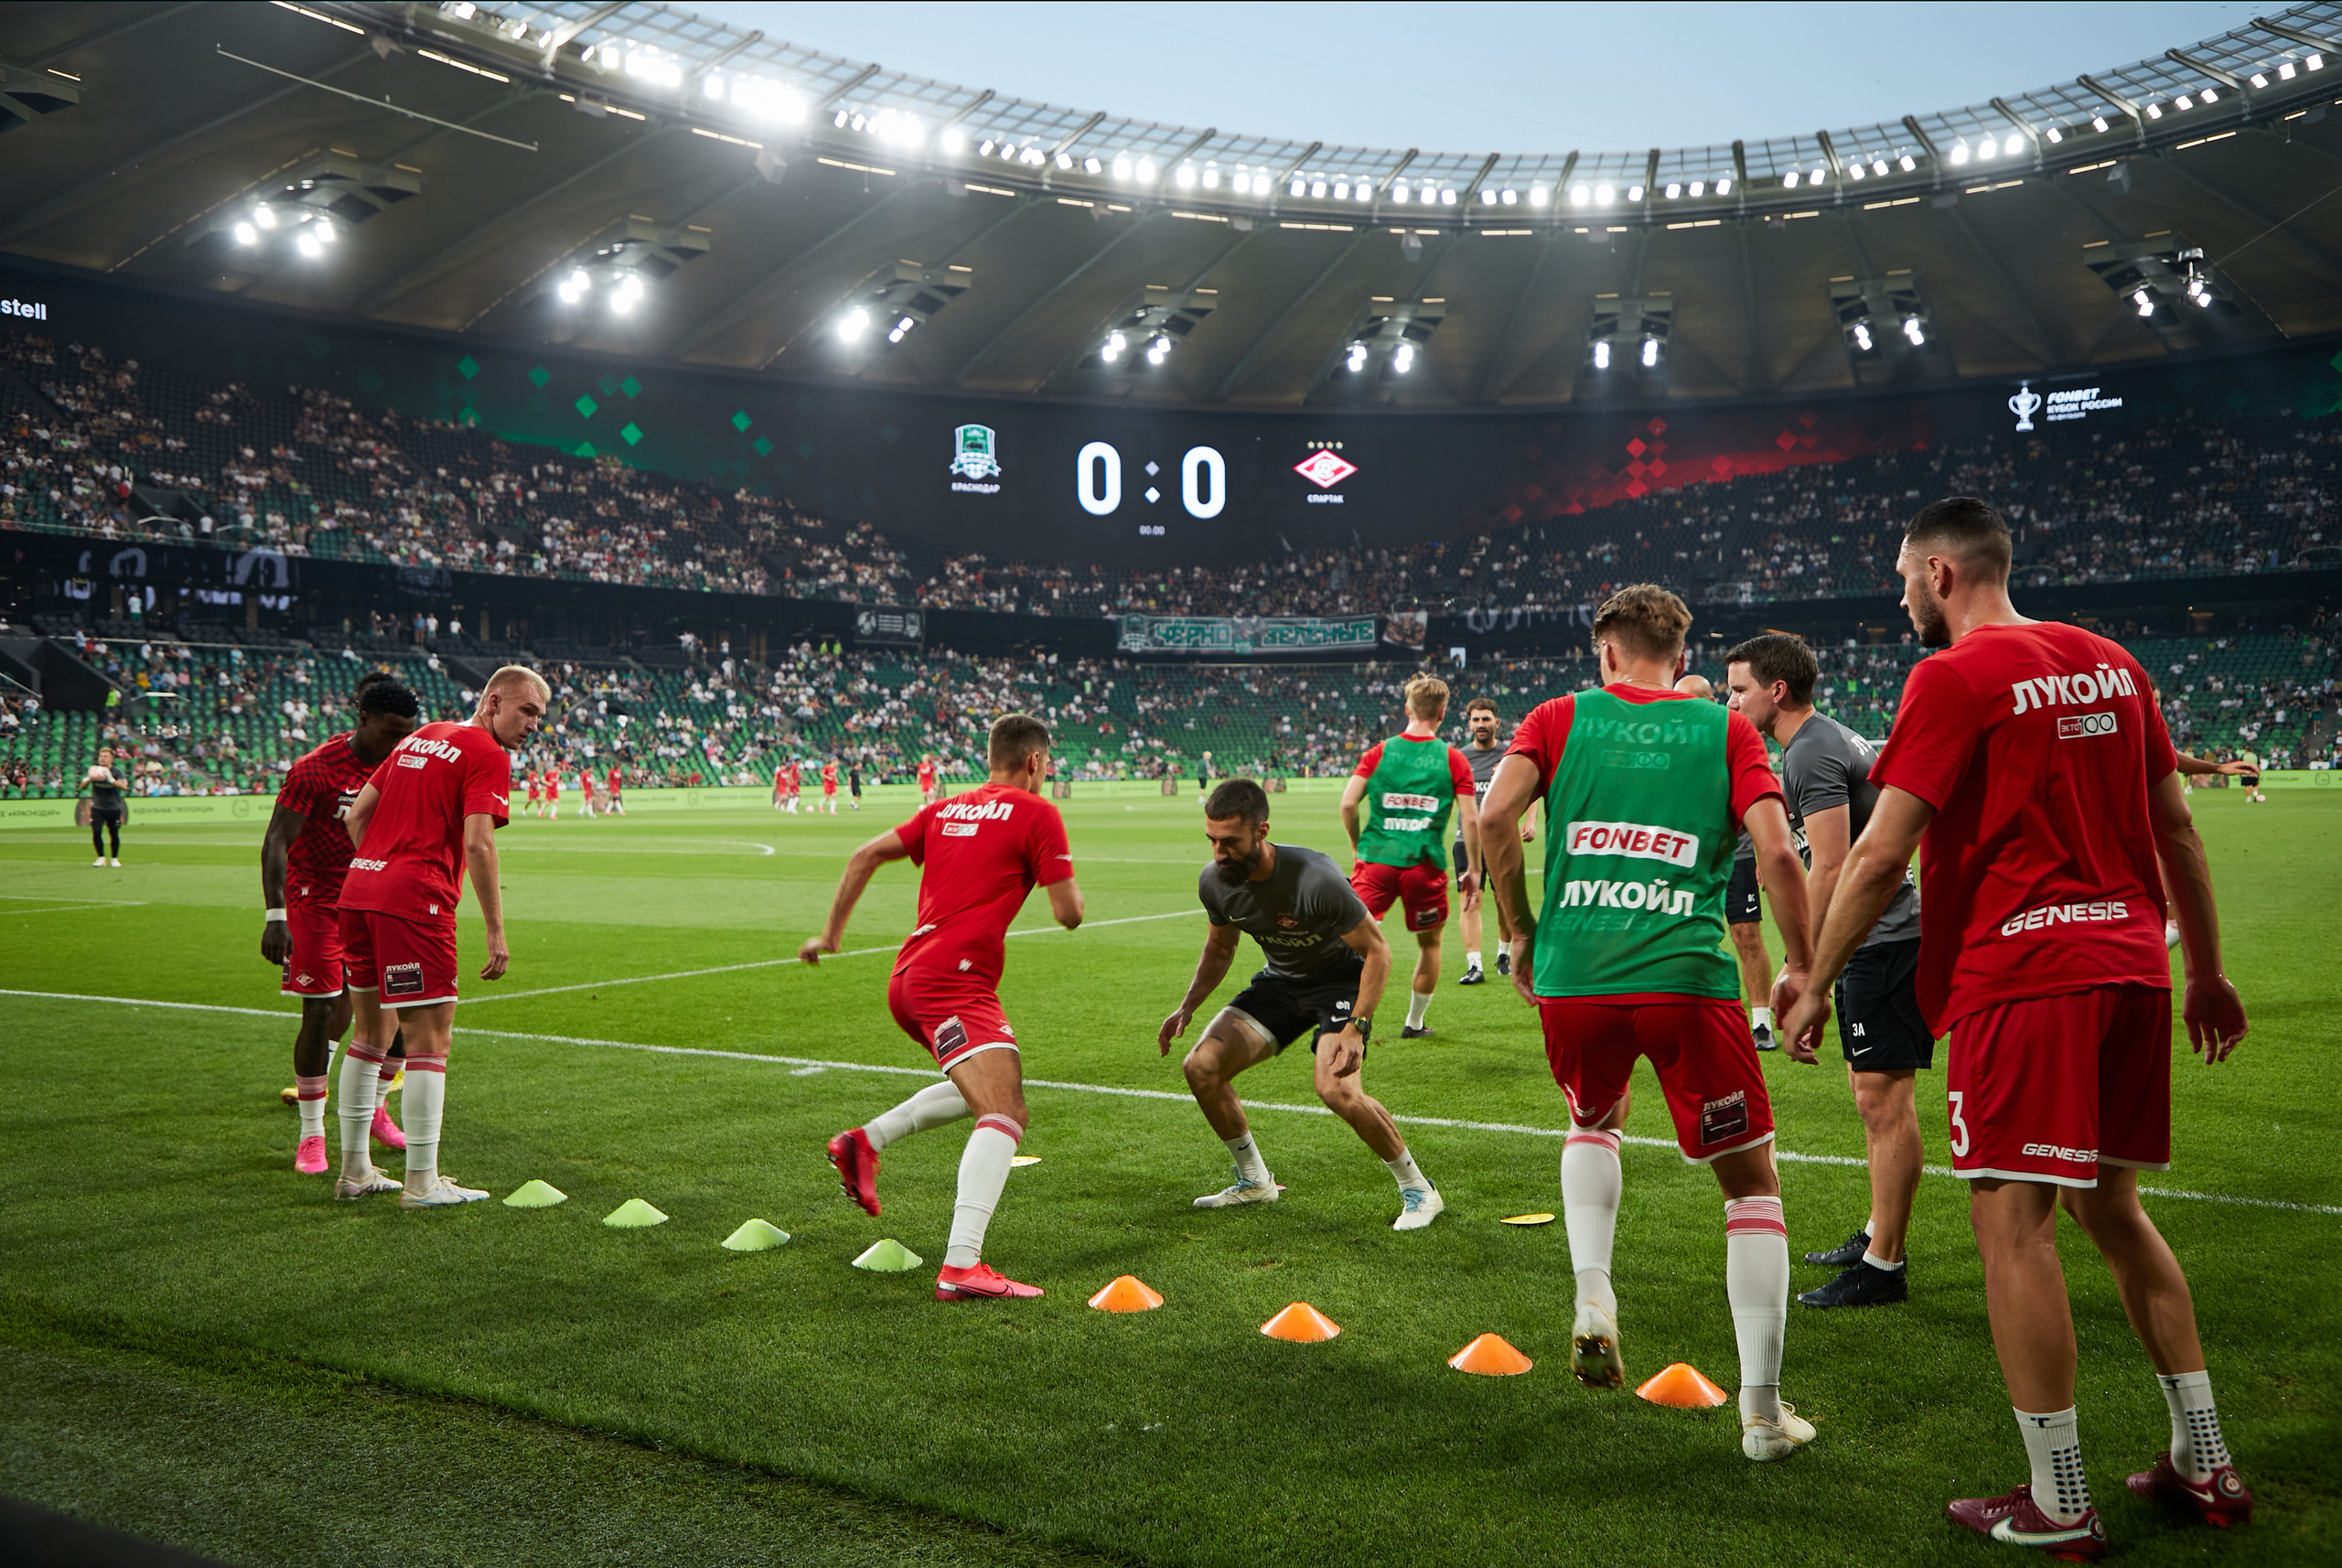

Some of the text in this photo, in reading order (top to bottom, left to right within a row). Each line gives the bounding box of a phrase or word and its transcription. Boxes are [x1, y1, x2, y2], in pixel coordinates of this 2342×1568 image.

[2047, 387, 2100, 404] FONBET
[2047, 397, 2122, 414] КУБОК РОССИИ
[951, 482, 1001, 494] КРАСНОДАР
[1077, 441, 1122, 516] 0
[1181, 446, 1226, 520] 0
[1306, 494, 1345, 504] СПАРТАК
[2012, 662, 2138, 715] ЛУКОЙЛ
[1572, 717, 1711, 746] ЛУКОЙЛ
[936, 800, 1015, 822] ЛУКОЙЛ
[1386, 795, 1435, 809] FONBET
[1573, 826, 1691, 859] FONBET
[1560, 877, 1695, 917] ЛУКОЙЛ
[2001, 901, 2130, 937] GENESIS
[386, 962, 420, 972] ЛУКОЙЛ
[1703, 1090, 1745, 1112] ЛУКОЙЛ
[2022, 1143, 2099, 1163] GENESIS
